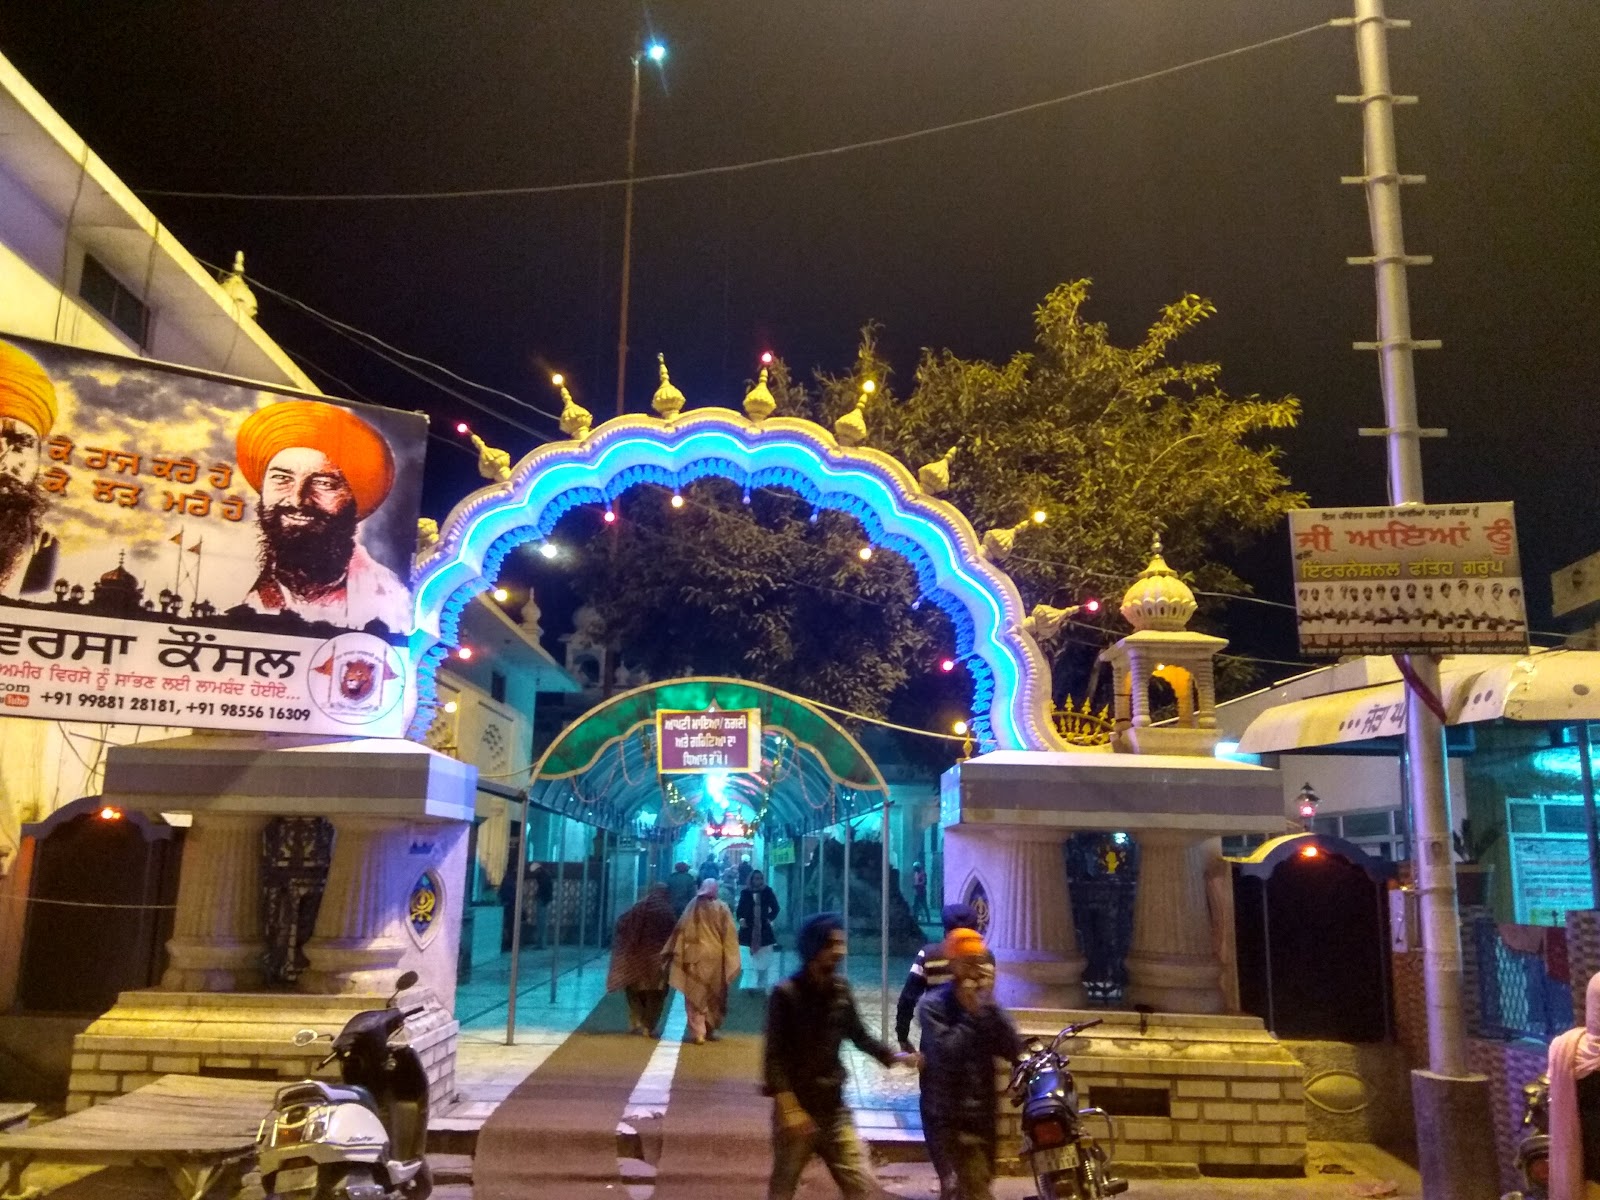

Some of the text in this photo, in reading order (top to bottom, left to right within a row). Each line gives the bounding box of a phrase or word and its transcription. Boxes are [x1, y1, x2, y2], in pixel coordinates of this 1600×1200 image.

[85, 446, 142, 475] ਰਾਜ
[1294, 518, 1514, 556] ਜੀ ਆਇਆਂ ਨੂੰ
[158, 626, 301, 679] ਕੌਂਸਲ
[50, 664, 91, 684] ਵਿਰਸੇ
[96, 668, 110, 690] ਨੂੰ
[115, 671, 158, 688] ਸਾਂਭਣ
[162, 674, 192, 692] ਲਈ
[196, 678, 245, 696] ਲਾਮਬੰਦ
[41, 692, 310, 721] +91 99881 28181, +91 98556 16309
[674, 733, 689, 748] ਅਤੇ
